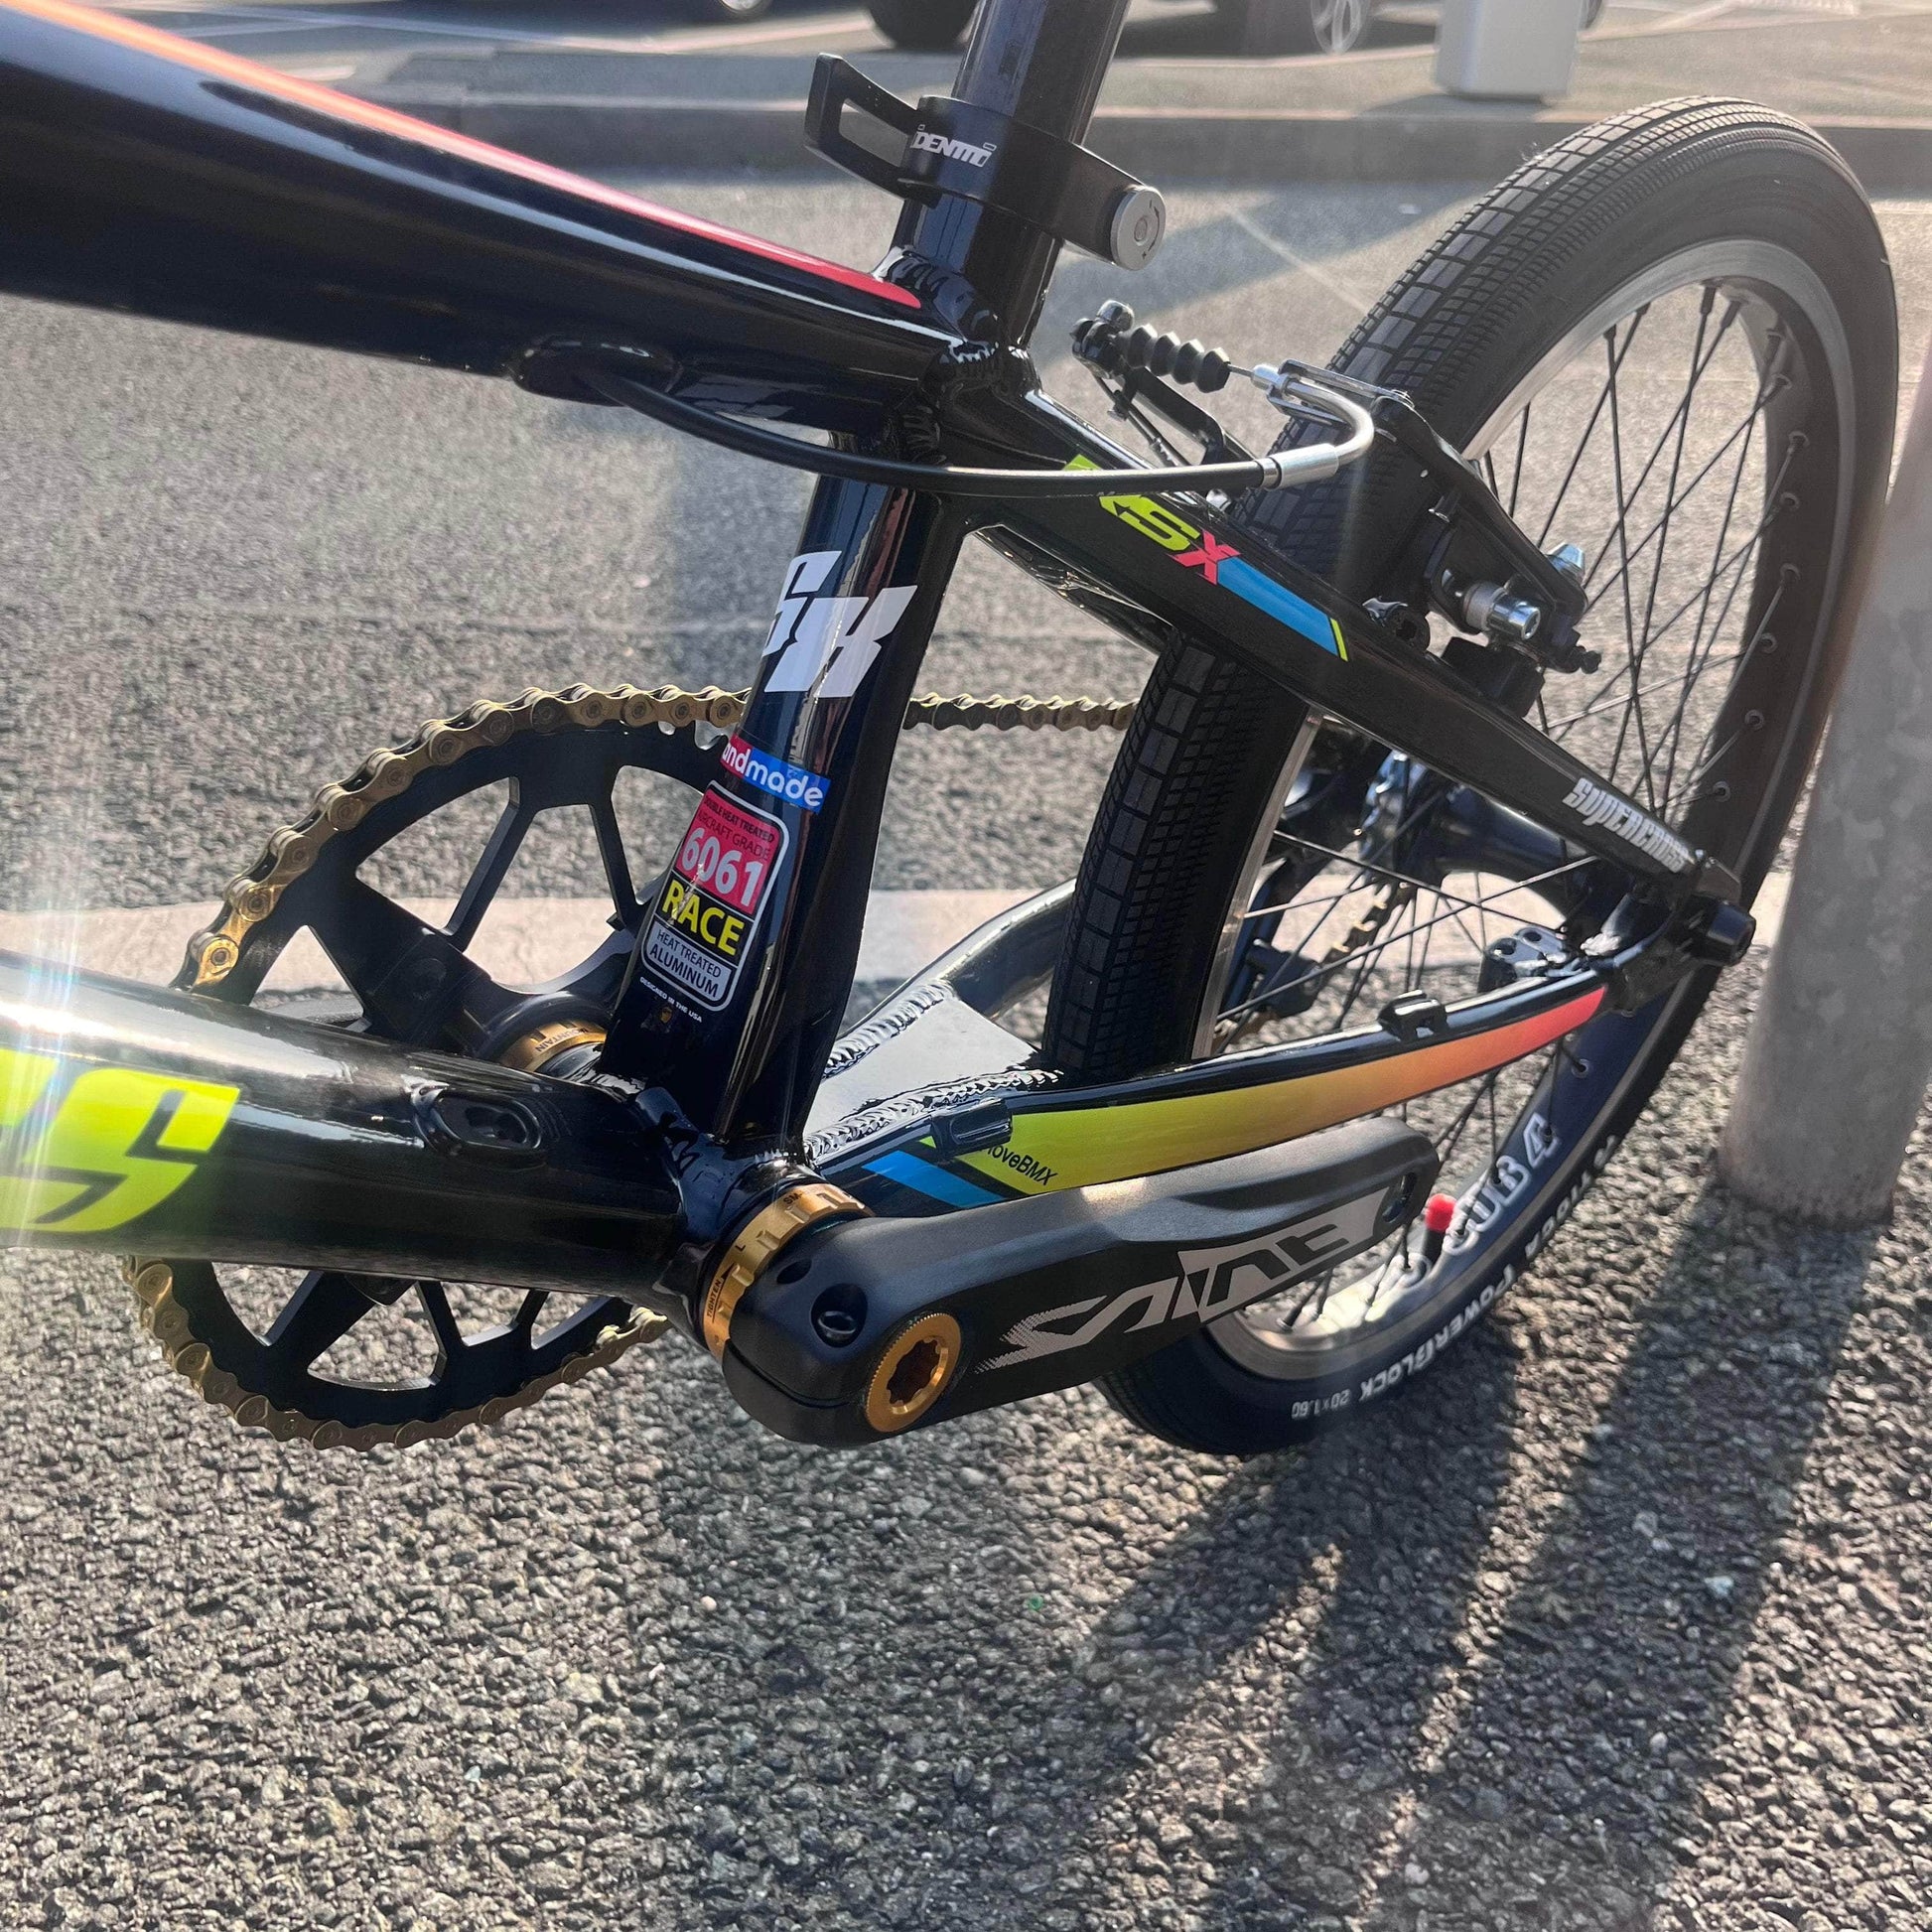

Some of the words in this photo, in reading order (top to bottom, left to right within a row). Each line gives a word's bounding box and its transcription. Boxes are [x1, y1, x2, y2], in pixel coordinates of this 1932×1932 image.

[761, 551, 917, 699] SX
[722, 807, 741, 825] HEAT
[739, 817, 775, 844] TREATED
[732, 833, 771, 861] GRADE
[682, 827, 763, 906] 6061
[662, 880, 745, 956] RACE
[650, 943, 719, 998] ALUMINUM
[656, 929, 681, 952] HEAT
[680, 944, 722, 978] TREATED
[706, 1279, 722, 1317] TIGHTEN
